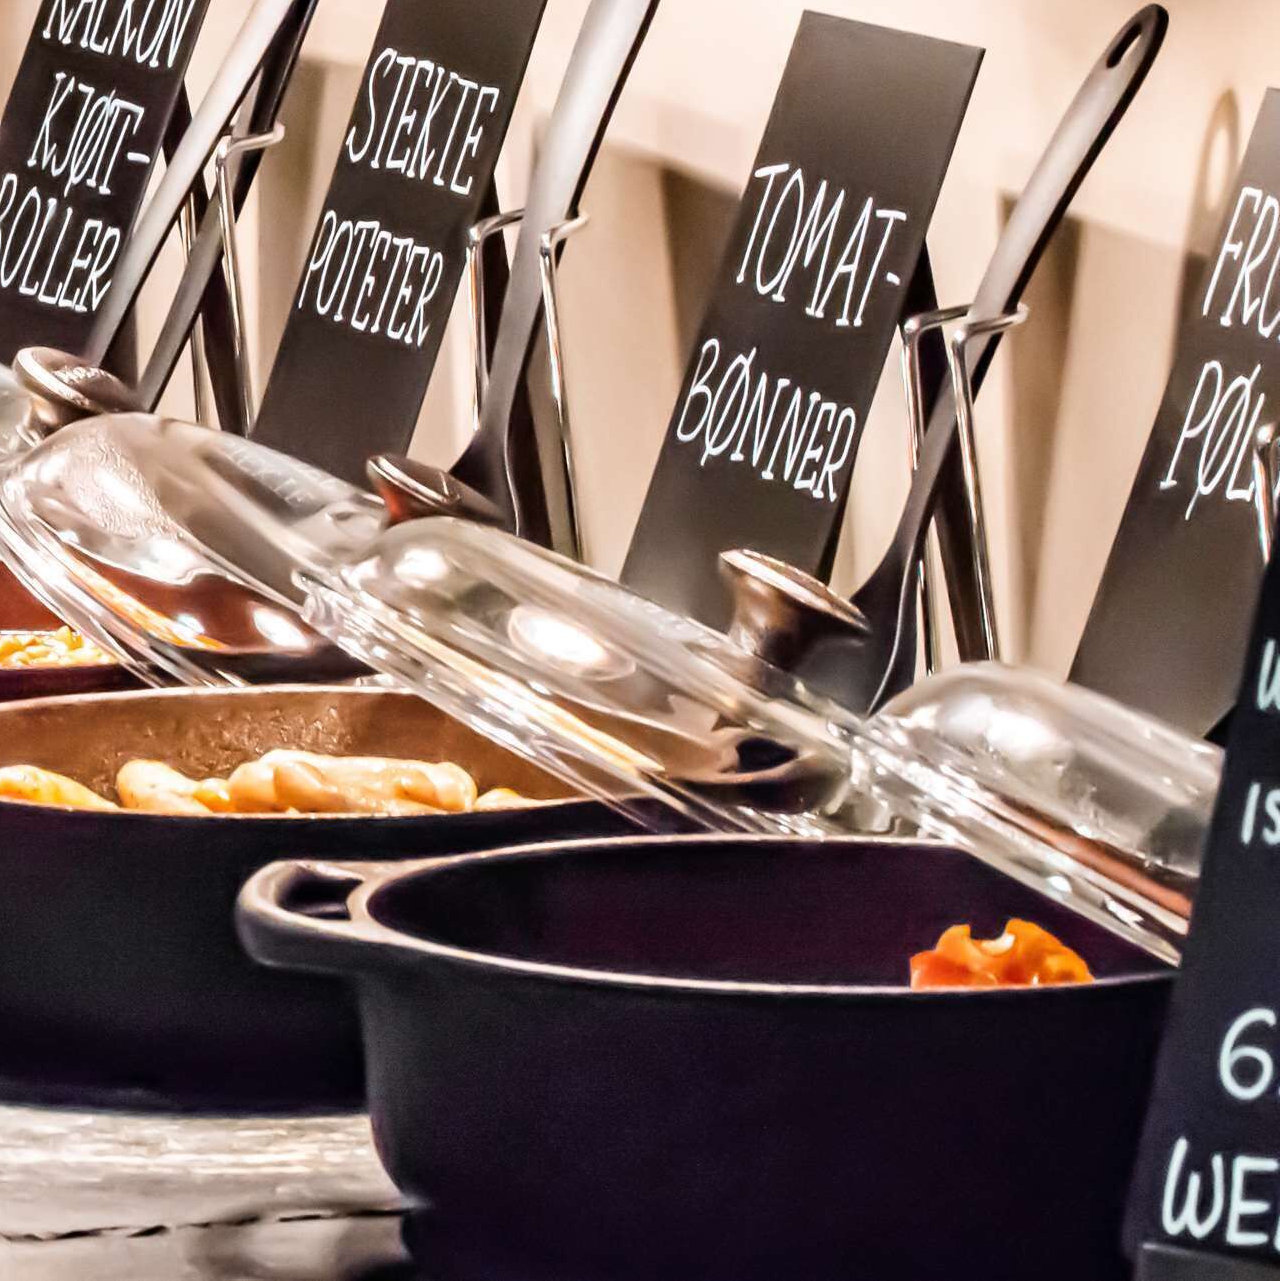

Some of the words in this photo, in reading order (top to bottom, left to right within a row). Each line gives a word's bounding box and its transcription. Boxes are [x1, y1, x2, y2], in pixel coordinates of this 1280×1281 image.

[345, 47, 500, 196] STEKTE
[298, 209, 444, 349] POTETER
[736, 163, 908, 327] TOMAT-
[677, 338, 857, 503] BØNNER
[1159, 360, 1280, 521] PØL
[1161, 1135, 1280, 1253] WE
